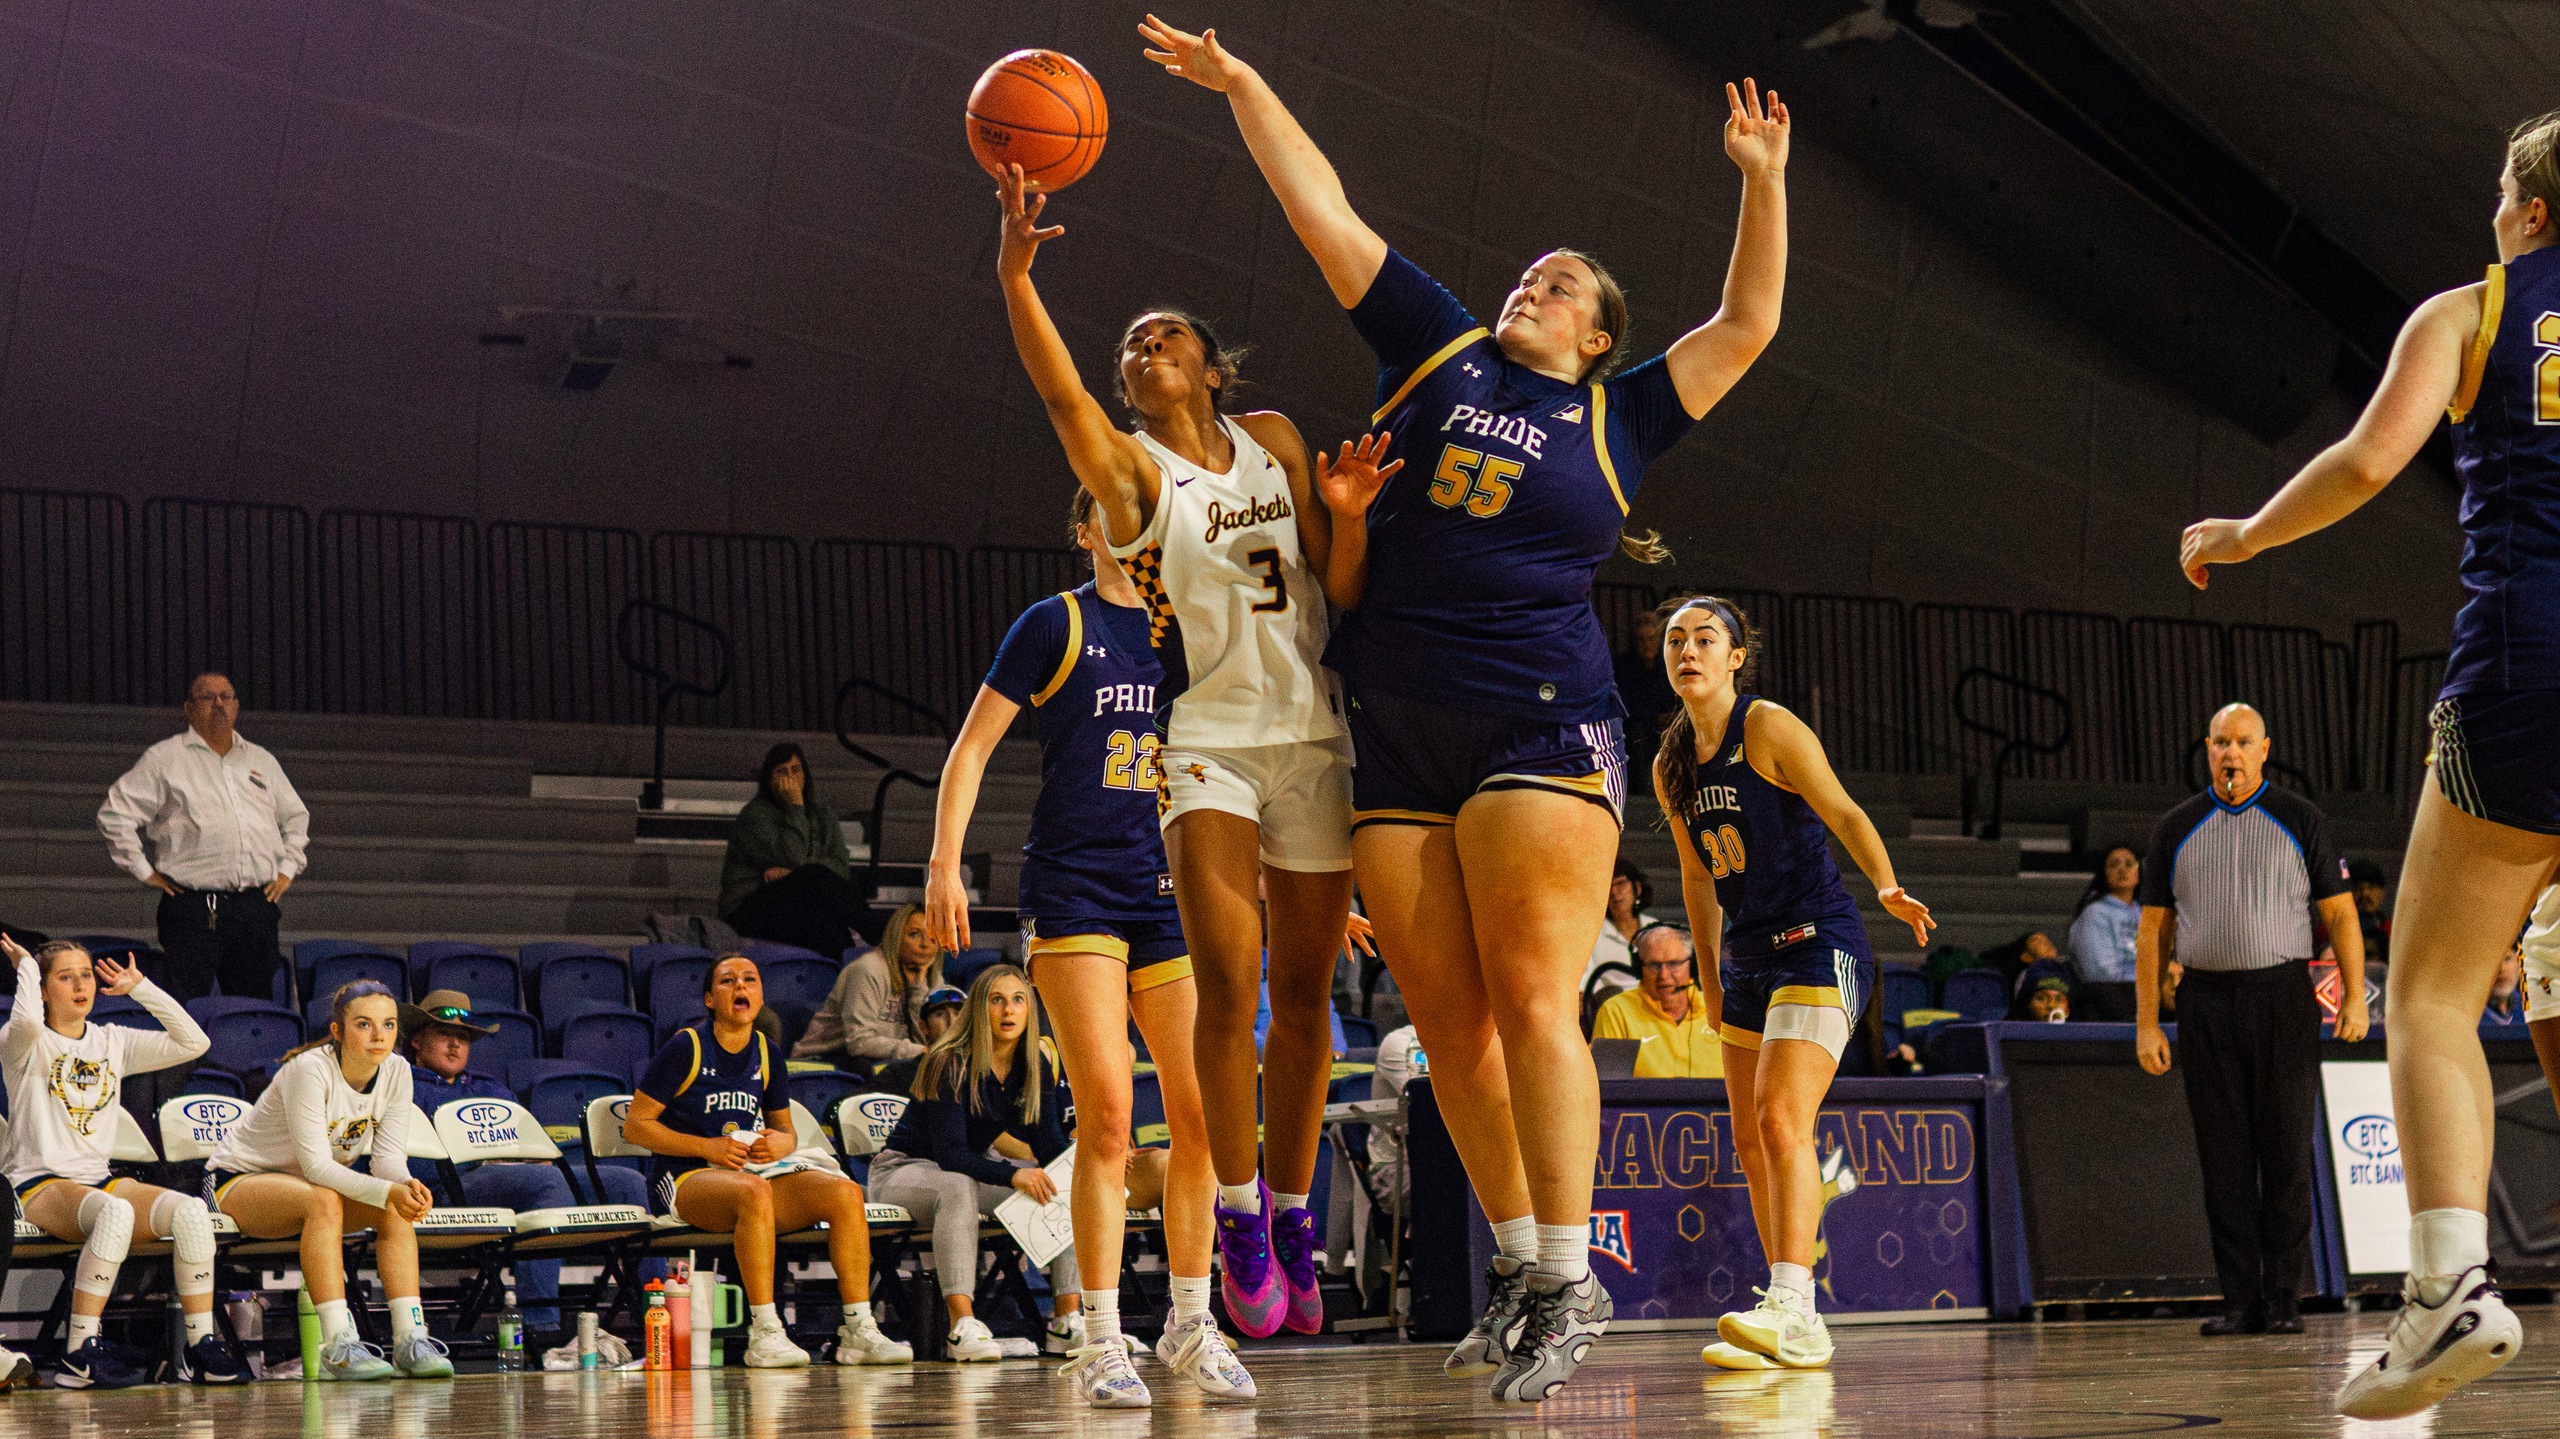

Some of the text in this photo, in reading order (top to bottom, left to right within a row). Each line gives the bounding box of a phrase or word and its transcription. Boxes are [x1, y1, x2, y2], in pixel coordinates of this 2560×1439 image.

[1440, 404, 1547, 460] PRIDE
[1427, 443, 1525, 518] 55
[1205, 493, 1291, 543] Jackets
[1246, 545, 1289, 614] 3
[1094, 683, 1155, 717] PRI
[1102, 729, 1159, 792] 22
[1701, 823, 1746, 879] 30
[199, 1104, 226, 1118] BTC
[471, 1106, 498, 1121] BTC
[704, 1091, 758, 1115] PRIDE
[873, 1103, 897, 1116] BTC
[193, 1128, 213, 1141] BTC
[467, 1127, 519, 1143] BTC BANK
[868, 1125, 887, 1137] BTC
[2361, 1124, 2388, 1146] BTC
[2351, 1163, 2404, 1185] BTC BAN
[566, 1211, 638, 1224] YELLOWJACKETS
